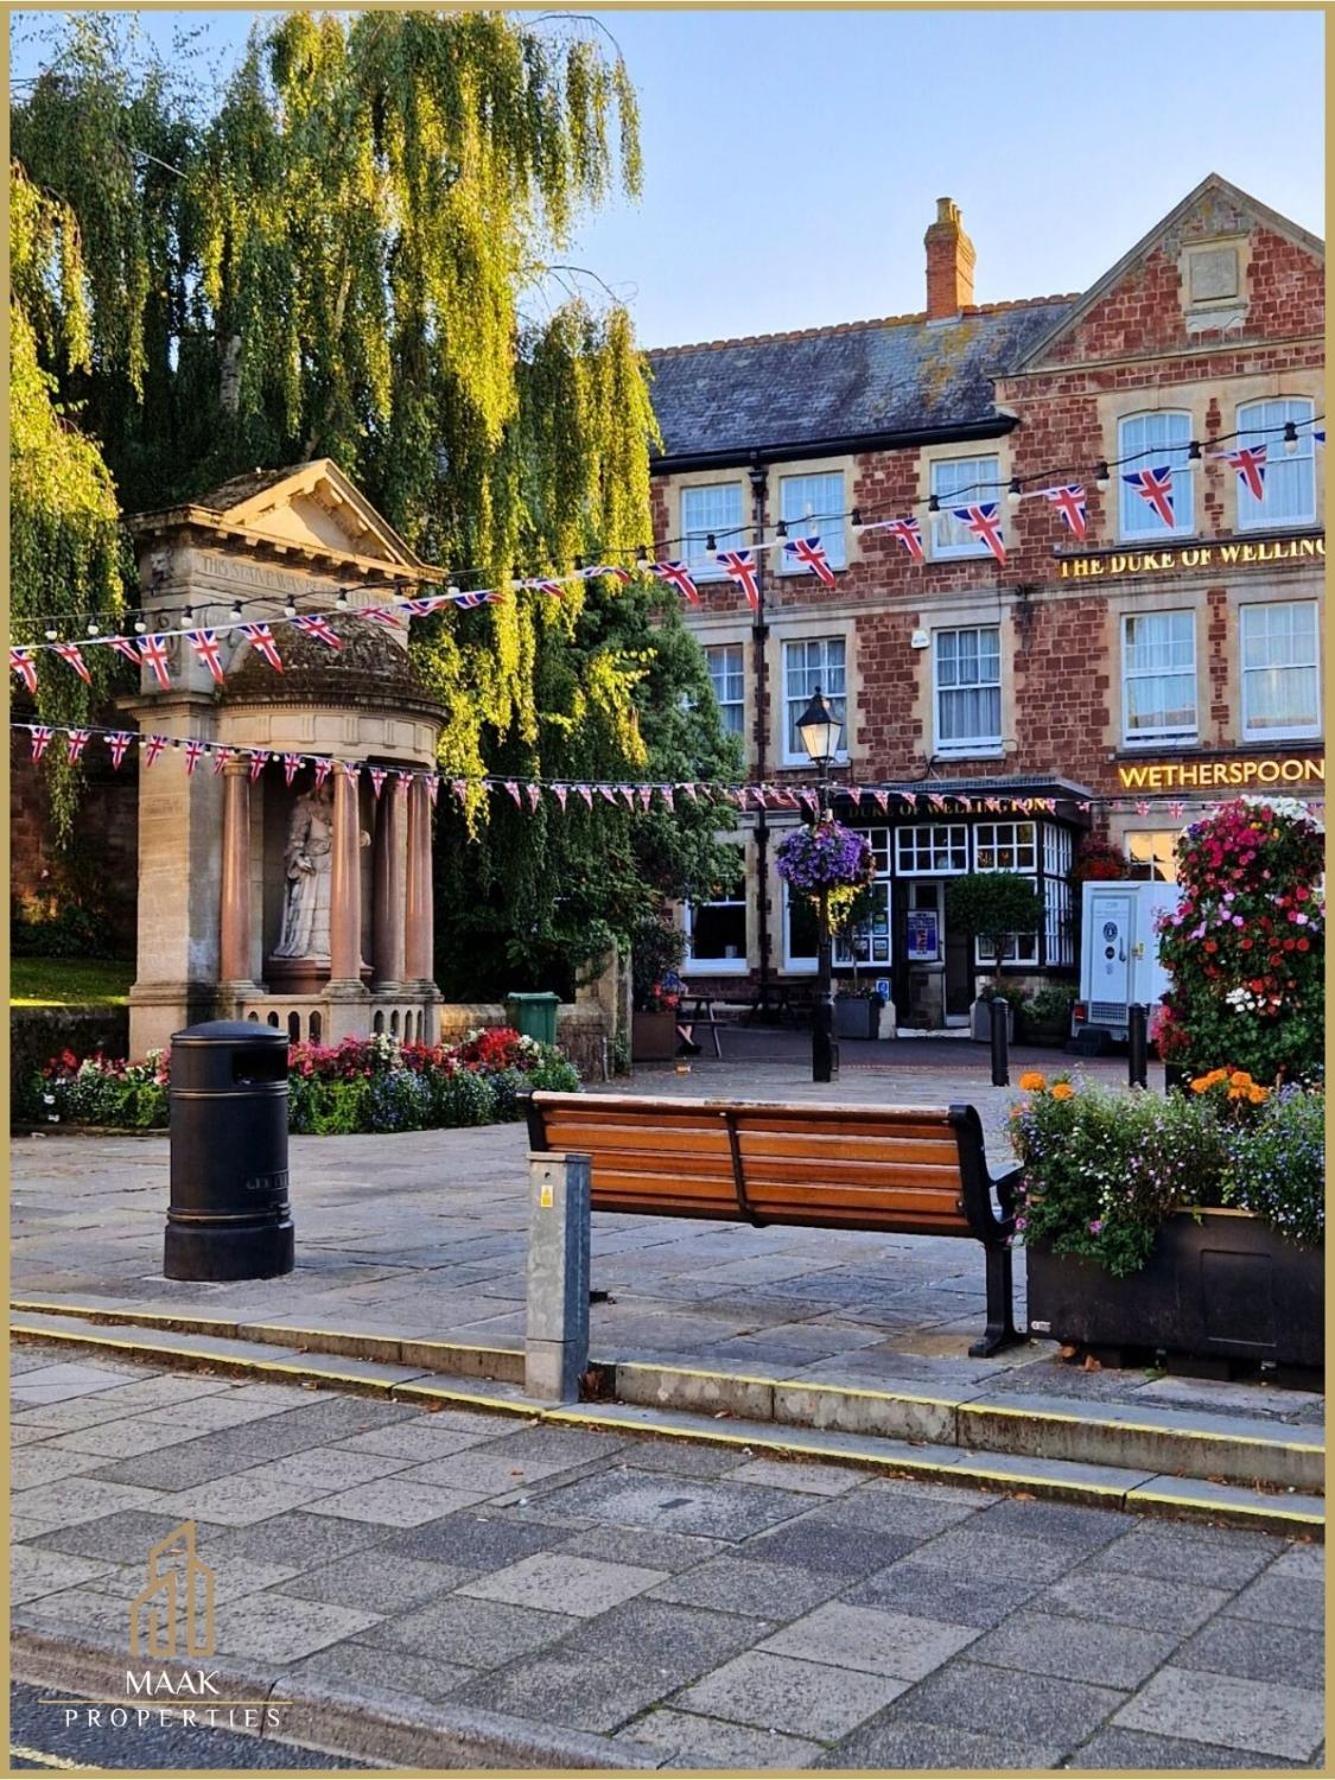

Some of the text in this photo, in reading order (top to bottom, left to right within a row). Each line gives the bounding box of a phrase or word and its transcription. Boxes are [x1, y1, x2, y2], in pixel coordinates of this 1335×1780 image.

[1061, 559, 1105, 578] THE
[1111, 553, 1175, 573] DUKE
[1181, 549, 1211, 567] OF
[1119, 759, 1325, 788] WETHERSPOON
[848, 805, 895, 817] DUK
